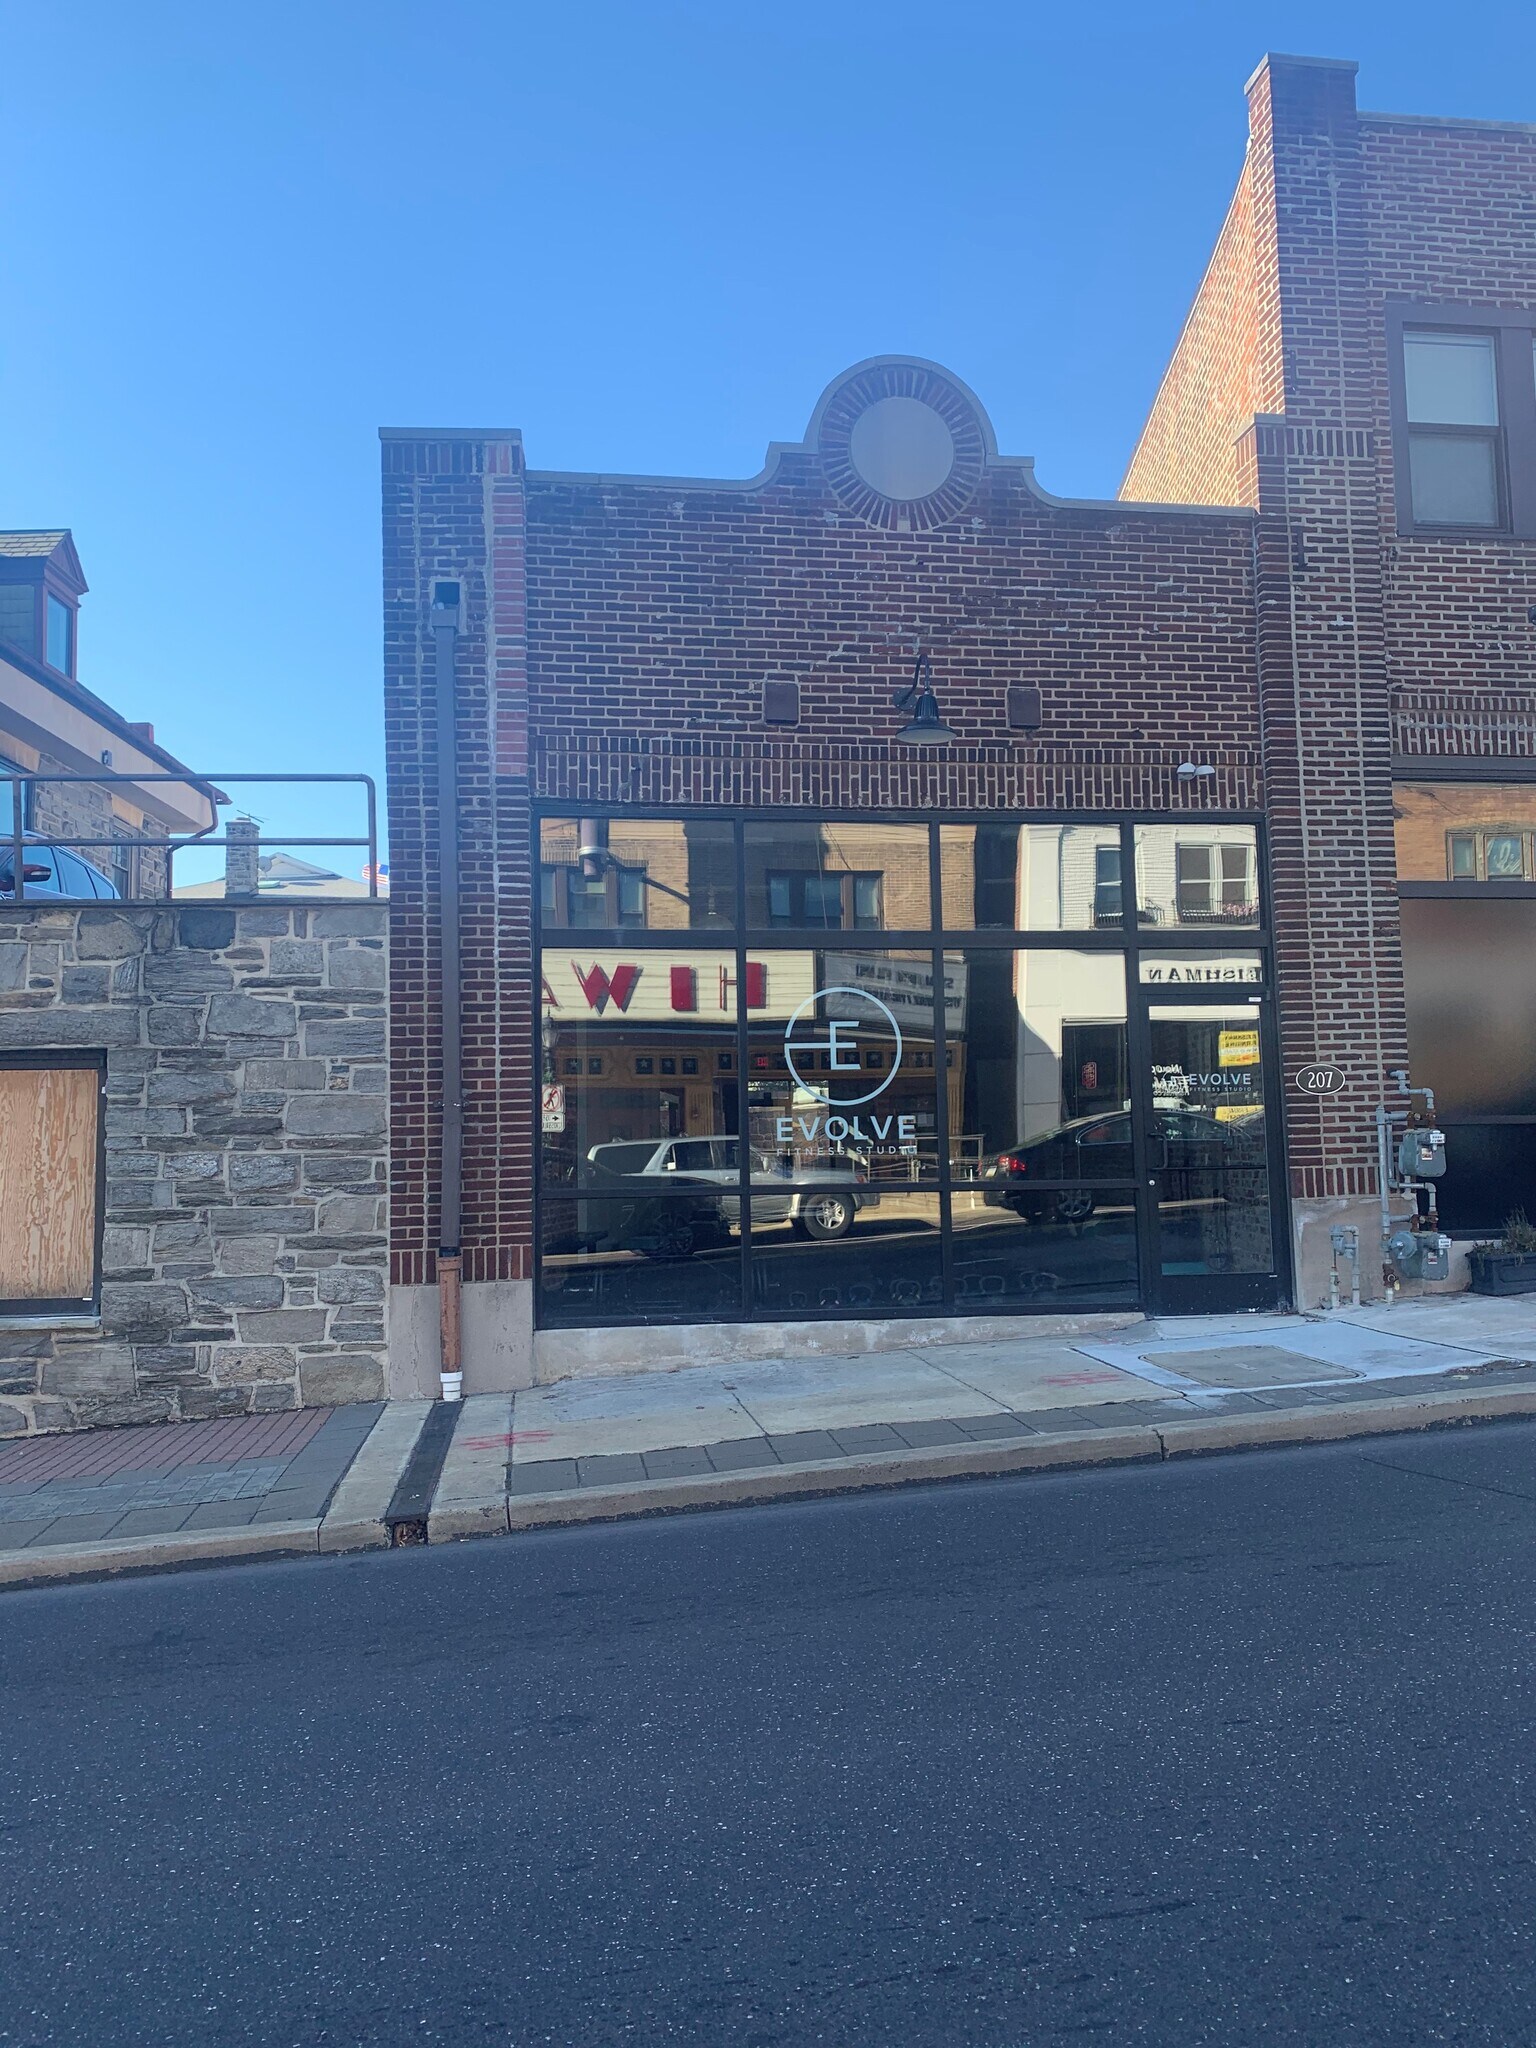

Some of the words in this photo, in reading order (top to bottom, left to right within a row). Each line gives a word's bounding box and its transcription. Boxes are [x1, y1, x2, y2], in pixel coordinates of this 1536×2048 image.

[1189, 1073, 1252, 1085] EVOLVE
[1307, 1071, 1333, 1088] 207
[776, 1115, 916, 1142] EVOLVE
[776, 1146, 845, 1157] FITNESS
